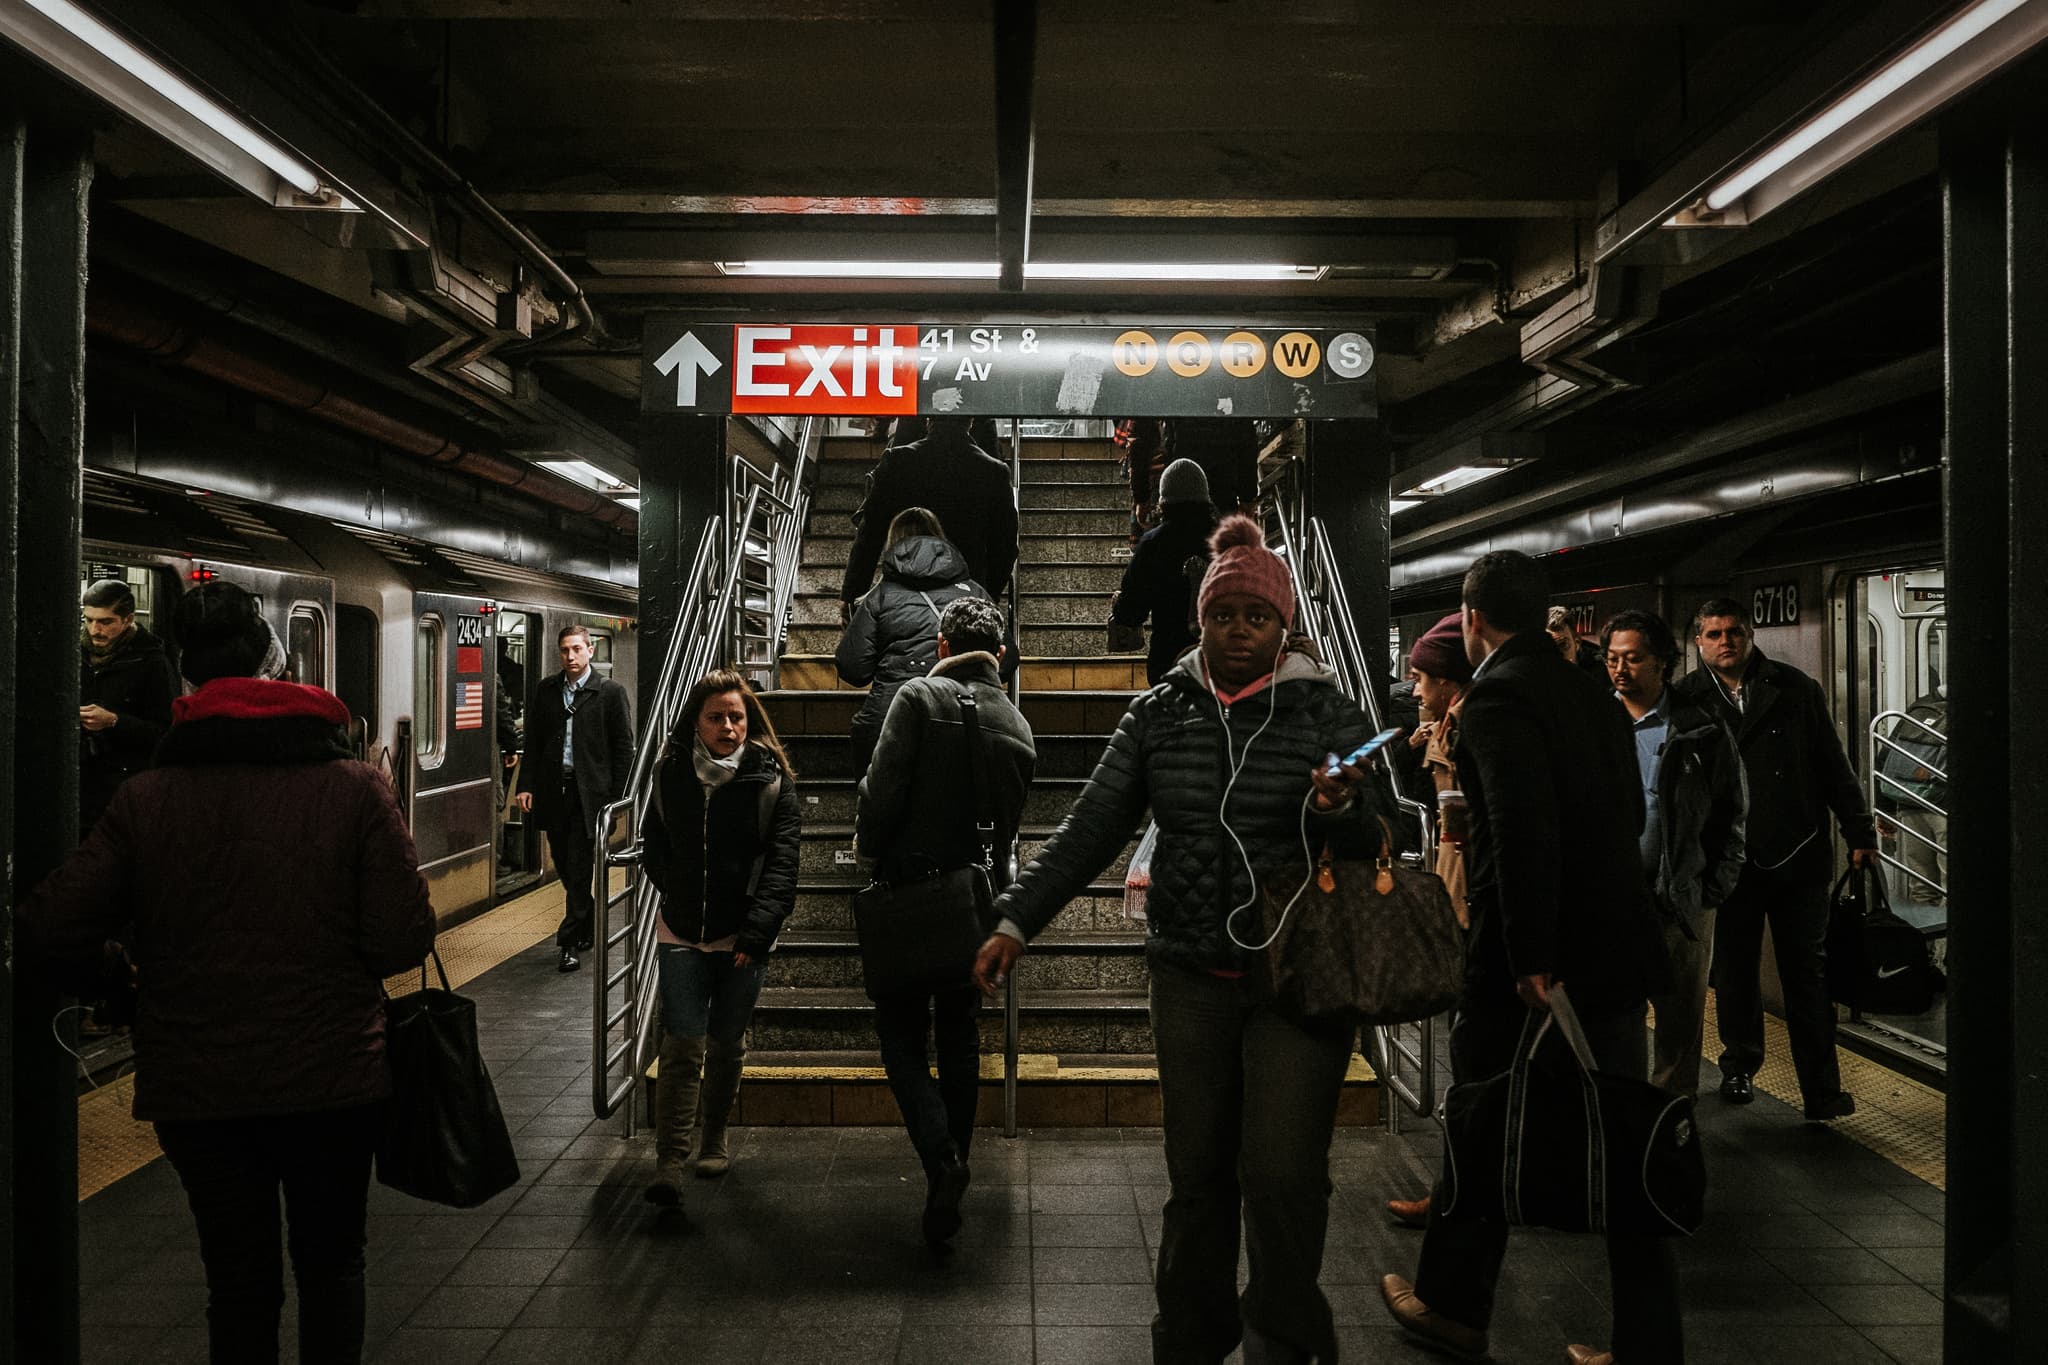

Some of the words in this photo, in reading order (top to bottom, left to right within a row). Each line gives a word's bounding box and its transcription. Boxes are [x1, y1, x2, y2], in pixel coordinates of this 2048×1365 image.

[920, 328, 954, 353] 41
[970, 328, 1002, 354] St
[1019, 328, 1040, 354] &
[1124, 341, 1146, 366] N
[1178, 341, 1201, 367] Q
[1232, 342, 1254, 367] R
[1280, 342, 1313, 367] W
[1339, 342, 1362, 369] S
[736, 327, 904, 397] Exit
[919, 356, 938, 381] 7
[954, 357, 993, 381] Av
[1753, 584, 1798, 624] 6718
[457, 616, 482, 645] 2434
